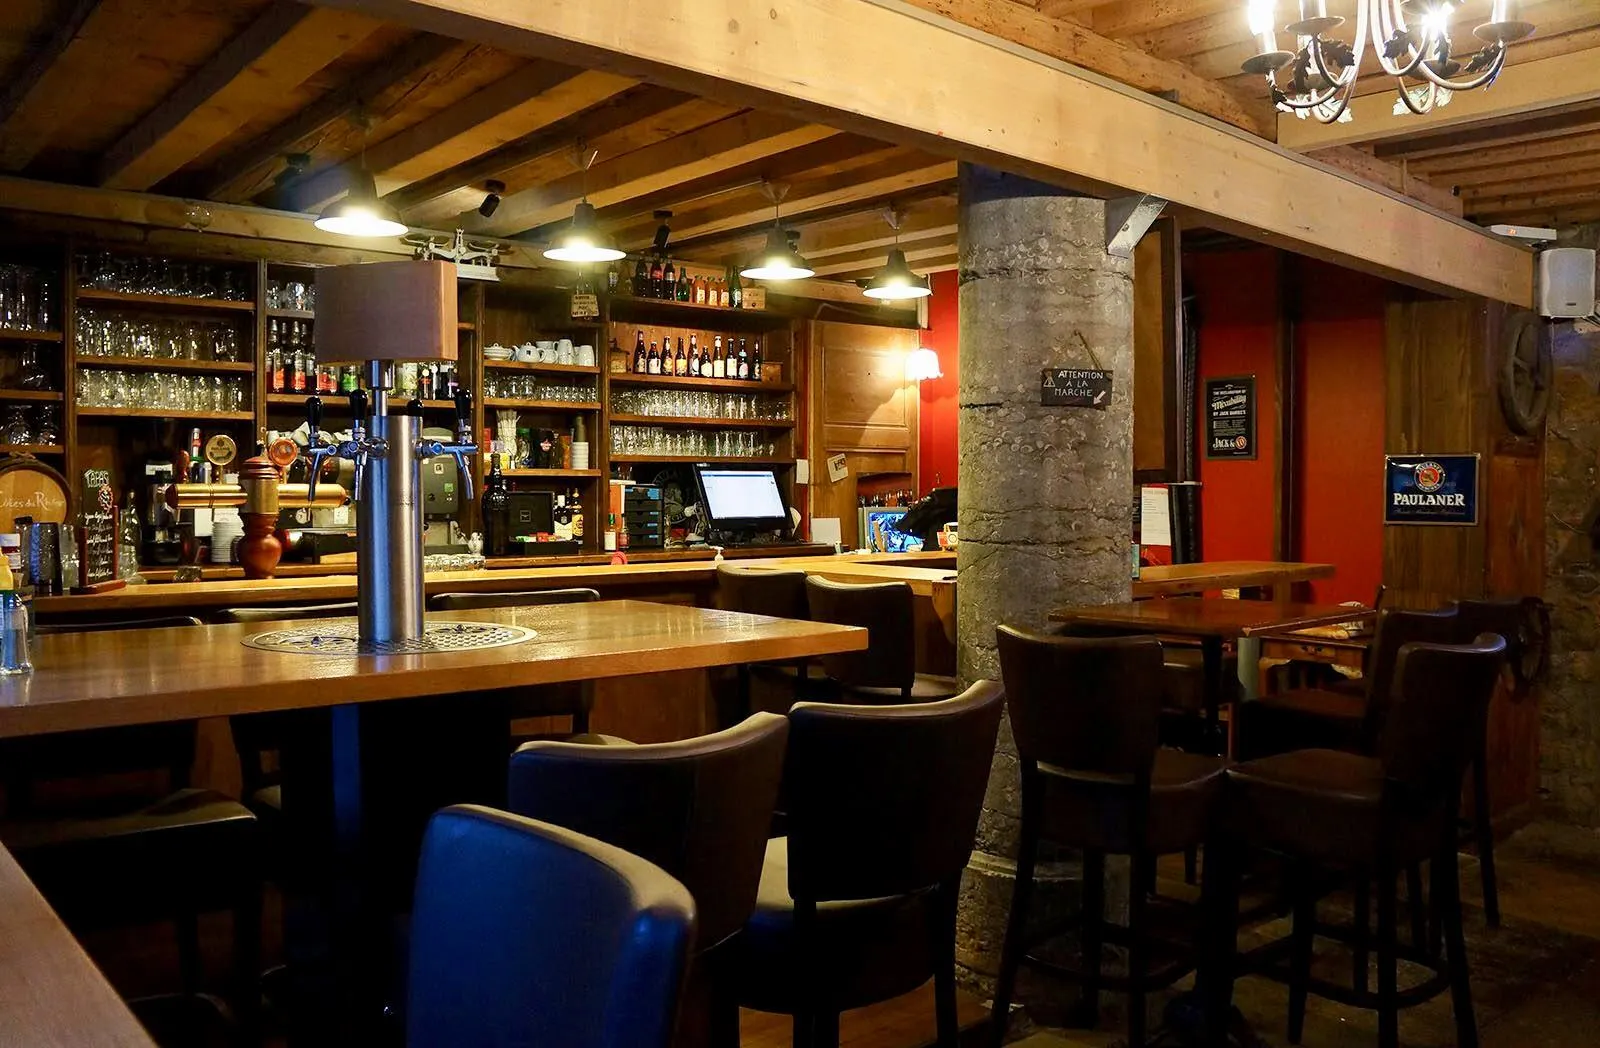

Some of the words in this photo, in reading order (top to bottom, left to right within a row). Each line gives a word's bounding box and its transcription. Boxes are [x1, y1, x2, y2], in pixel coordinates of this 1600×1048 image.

[1058, 370, 1103, 379] ATTENTION
[1077, 380, 1088, 388] LA
[1054, 388, 1093, 397] MARCHE
[83, 469, 110, 488] TAPAS
[1393, 493, 1466, 506] PAULANER
